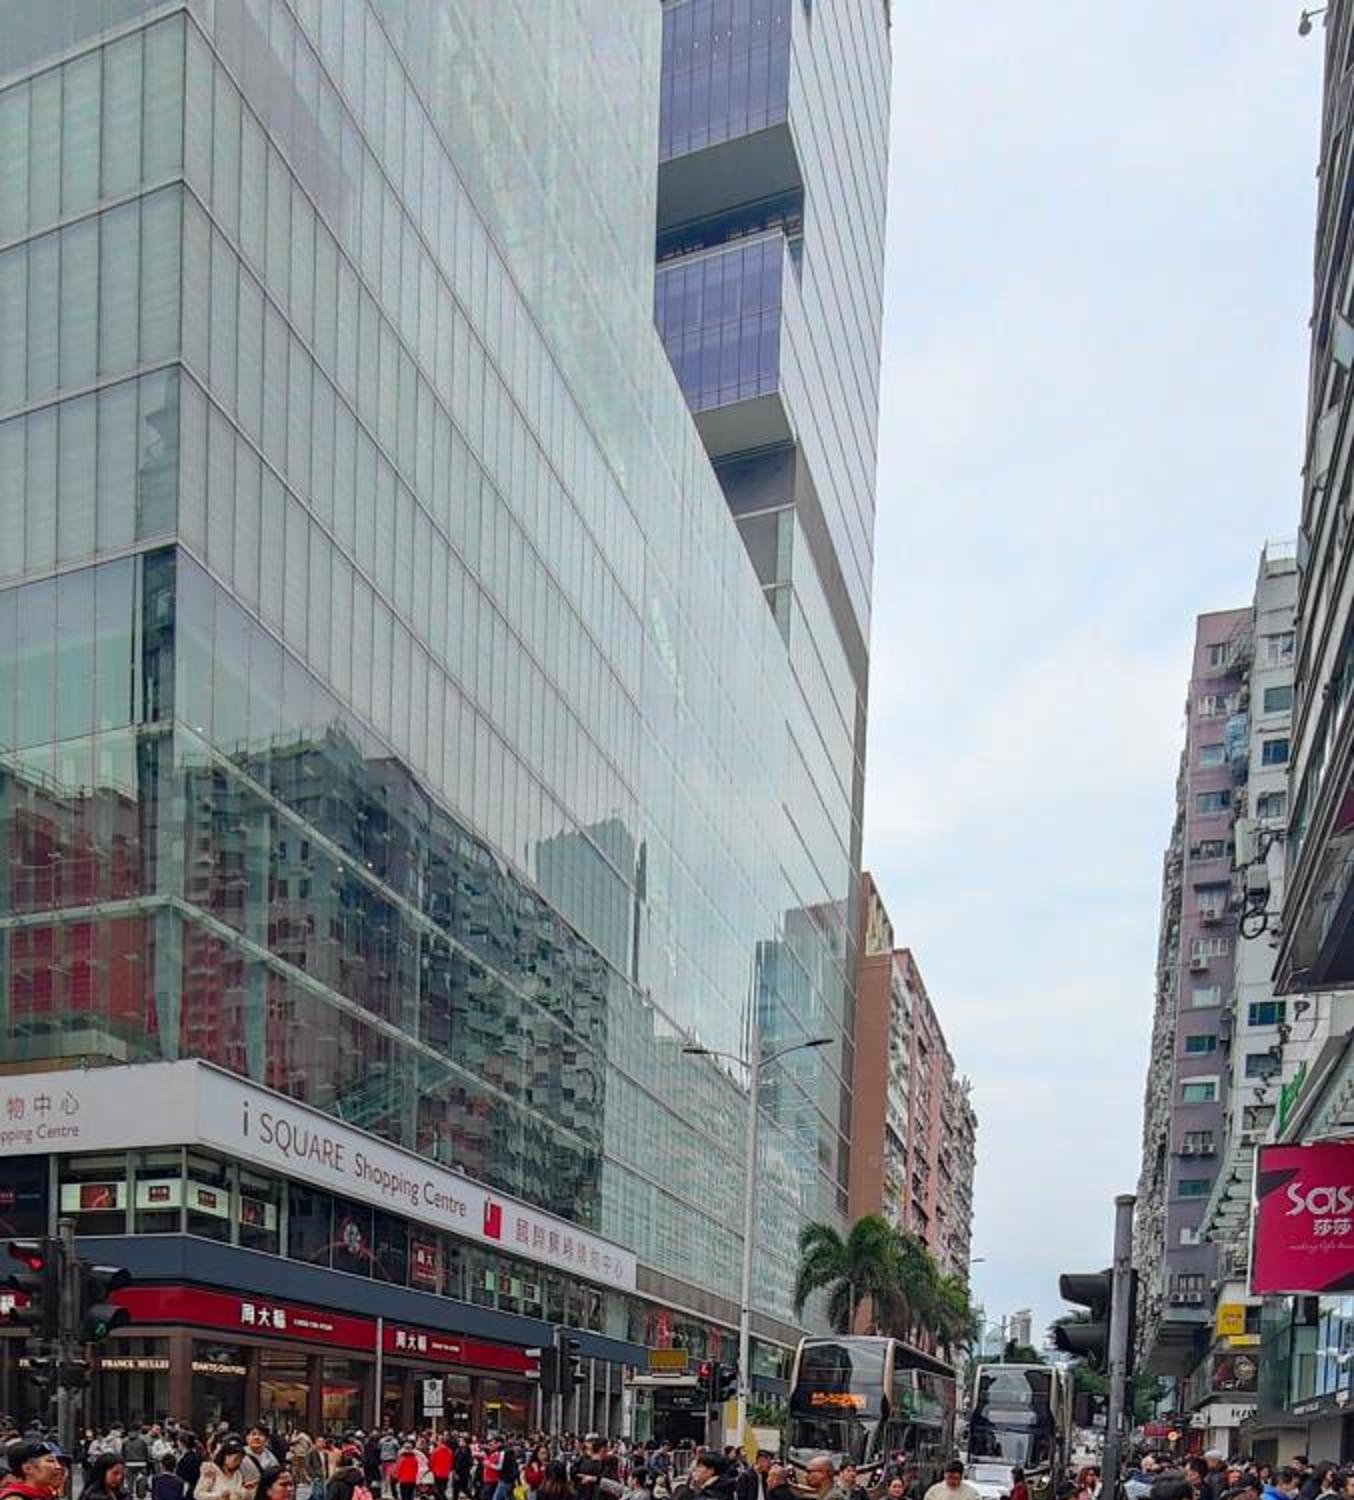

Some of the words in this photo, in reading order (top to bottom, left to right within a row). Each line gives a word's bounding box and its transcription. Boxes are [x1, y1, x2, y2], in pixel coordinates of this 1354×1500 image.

[7, 1091, 80, 1120] 物中心
[36, 1123, 80, 1140] Centre
[242, 1101, 250, 1137] i
[259, 1112, 345, 1173] SQUARE
[354, 1153, 420, 1207] Shopping
[423, 1180, 468, 1217] Centre
[1285, 1182, 1354, 1217] Sas
